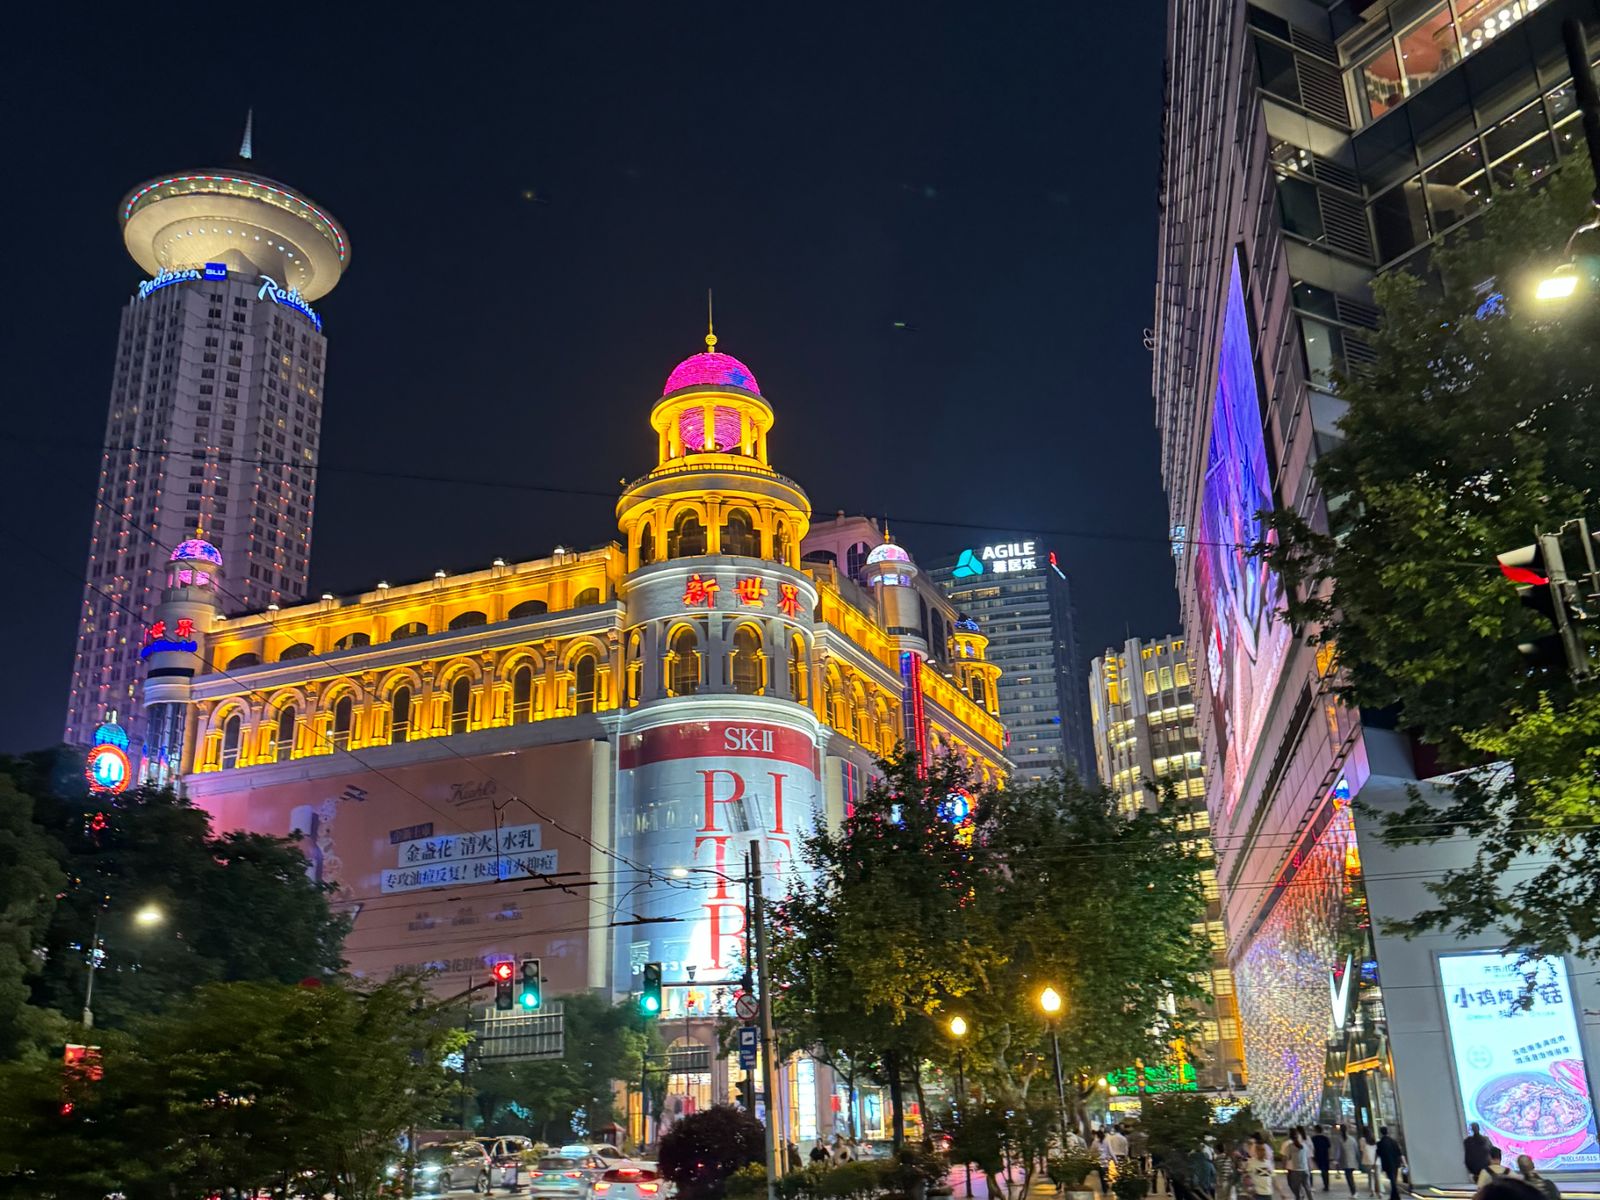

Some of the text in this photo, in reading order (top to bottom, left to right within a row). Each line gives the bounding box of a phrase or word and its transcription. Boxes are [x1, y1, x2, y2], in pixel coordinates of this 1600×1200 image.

[138, 268, 202, 299] Radisson
[982, 542, 1035, 560] AGILE
[682, 573, 806, 621] 新世界
